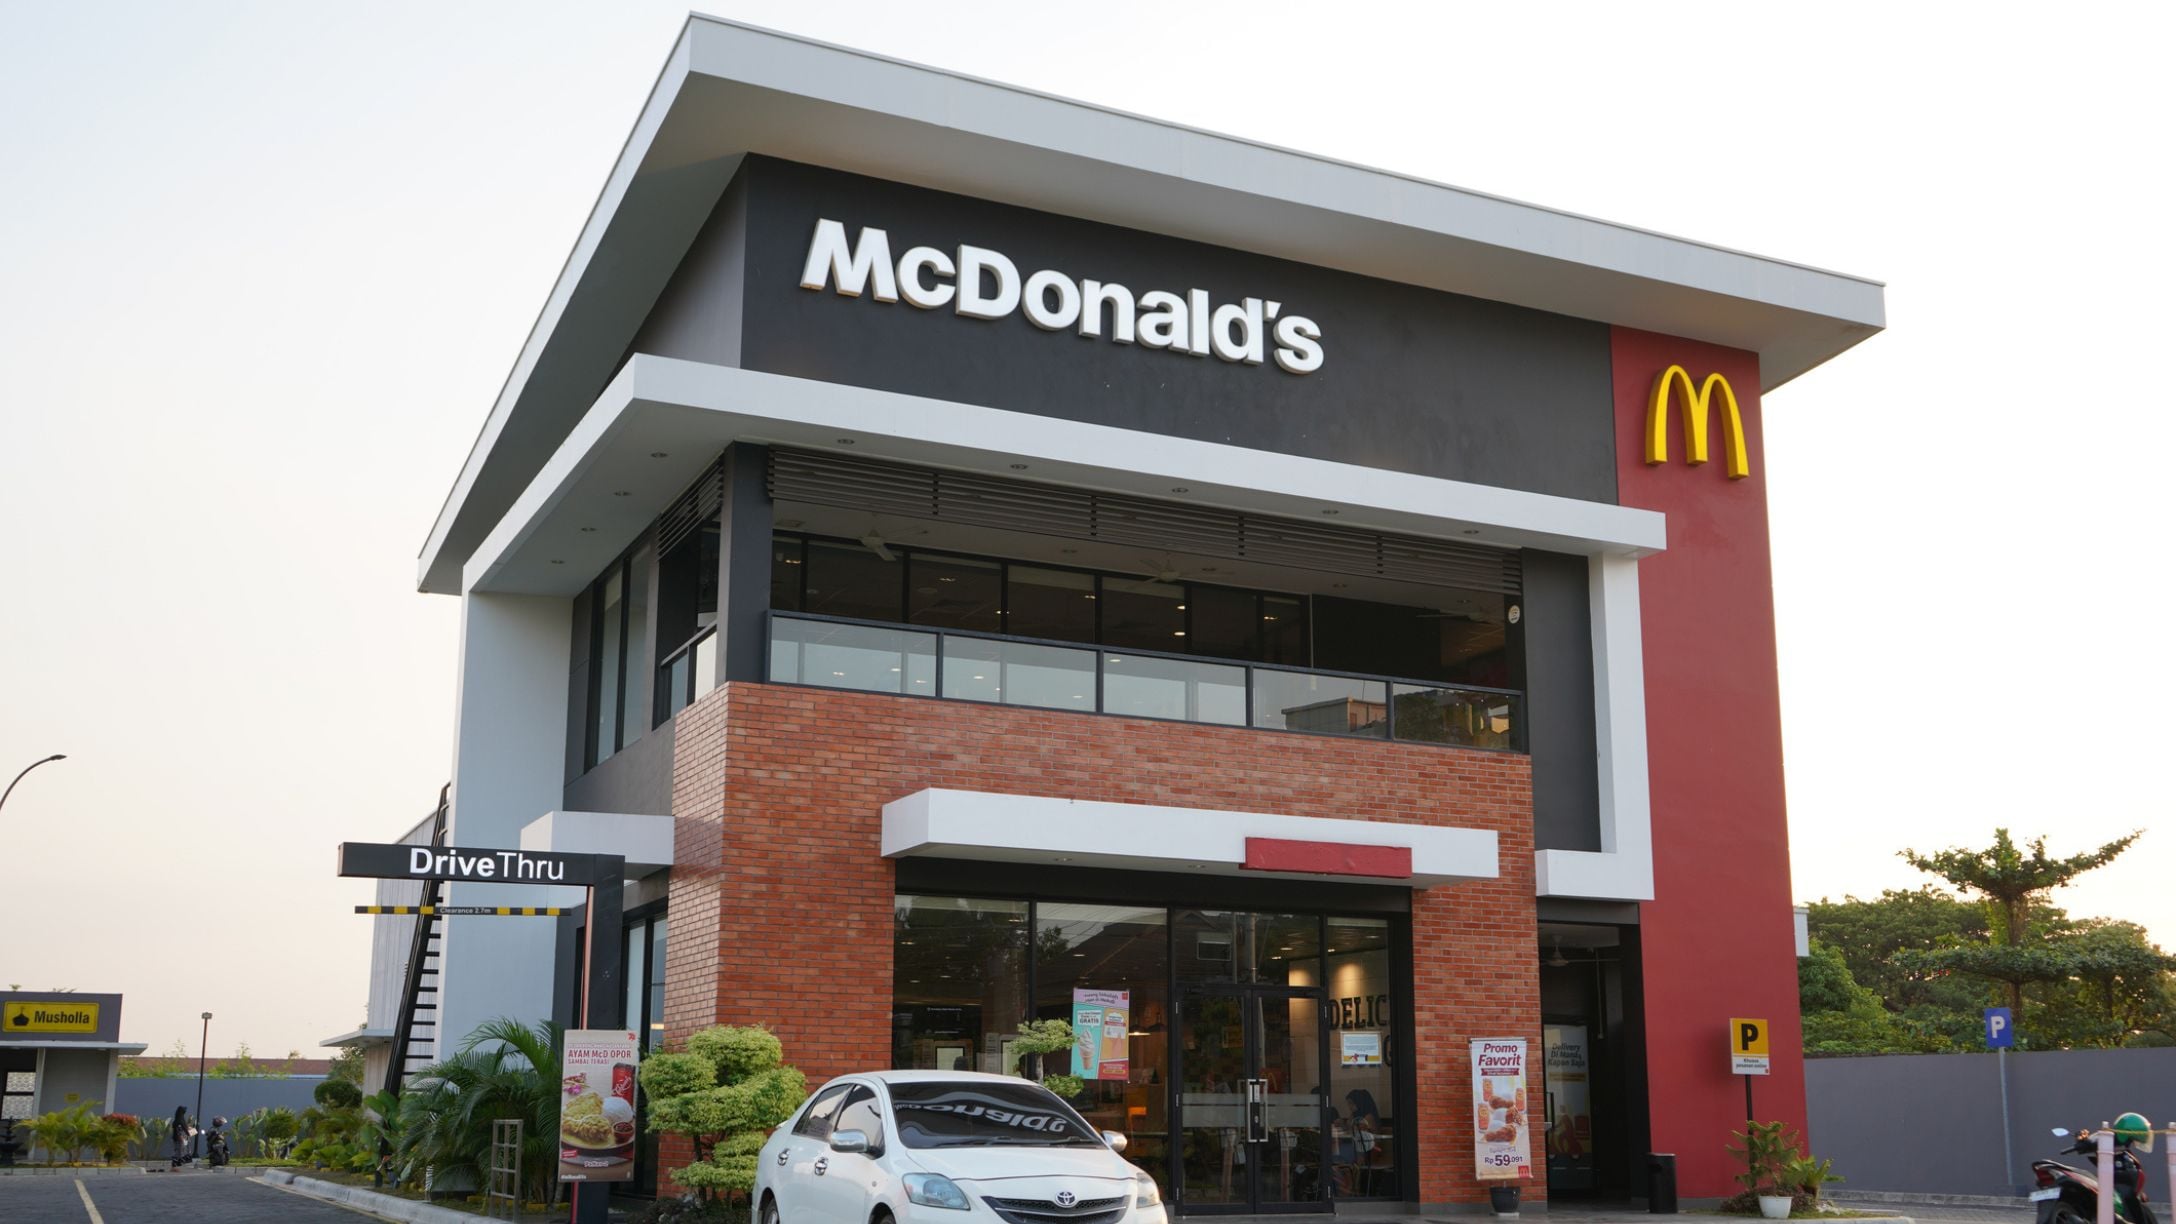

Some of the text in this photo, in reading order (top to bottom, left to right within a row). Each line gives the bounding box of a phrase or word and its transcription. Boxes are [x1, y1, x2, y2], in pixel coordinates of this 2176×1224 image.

[800, 217, 1325, 375] McDonald's
[34, 1010, 90, 1024] Musholla
[1990, 1016, 2005, 1039] P
[1741, 1023, 1759, 1050] P
[568, 1049, 632, 1058] AYAM McD OPOR
[1483, 1042, 1518, 1053] Promo
[1478, 1053, 1521, 1066] Favorit
[1484, 1156, 1494, 1165] Rp
